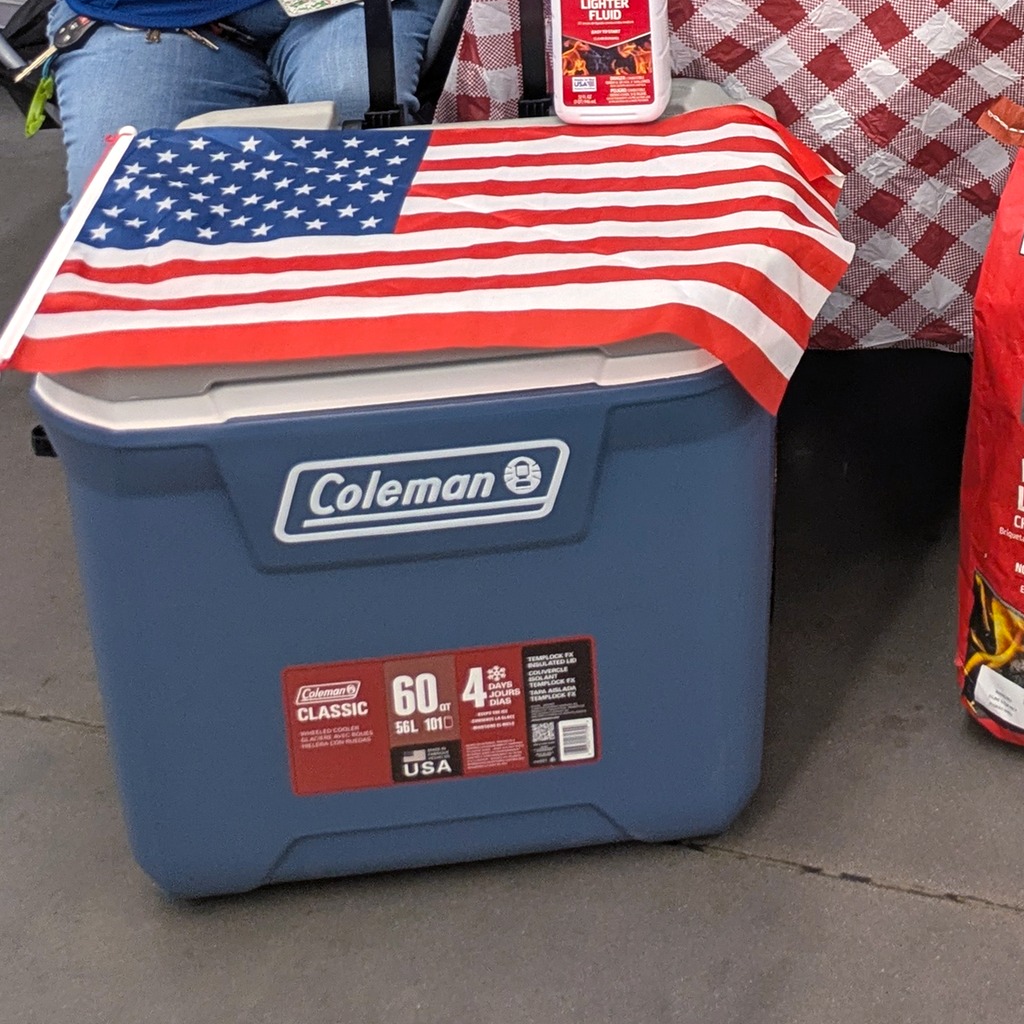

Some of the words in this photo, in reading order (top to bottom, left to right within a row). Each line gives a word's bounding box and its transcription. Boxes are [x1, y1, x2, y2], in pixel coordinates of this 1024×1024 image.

[589, 10, 622, 21] FLUID
[310, 470, 495, 516] Coleman
[462, 667, 487, 708] 4
[488, 681, 512, 690] DAYS
[489, 688, 520, 698] JOURS
[302, 687, 345, 701] Coleman
[393, 672, 438, 716] 60
[297, 701, 368, 721] CLASSIC
[395, 720, 418, 734] 56L
[403, 760, 452, 776] USA
